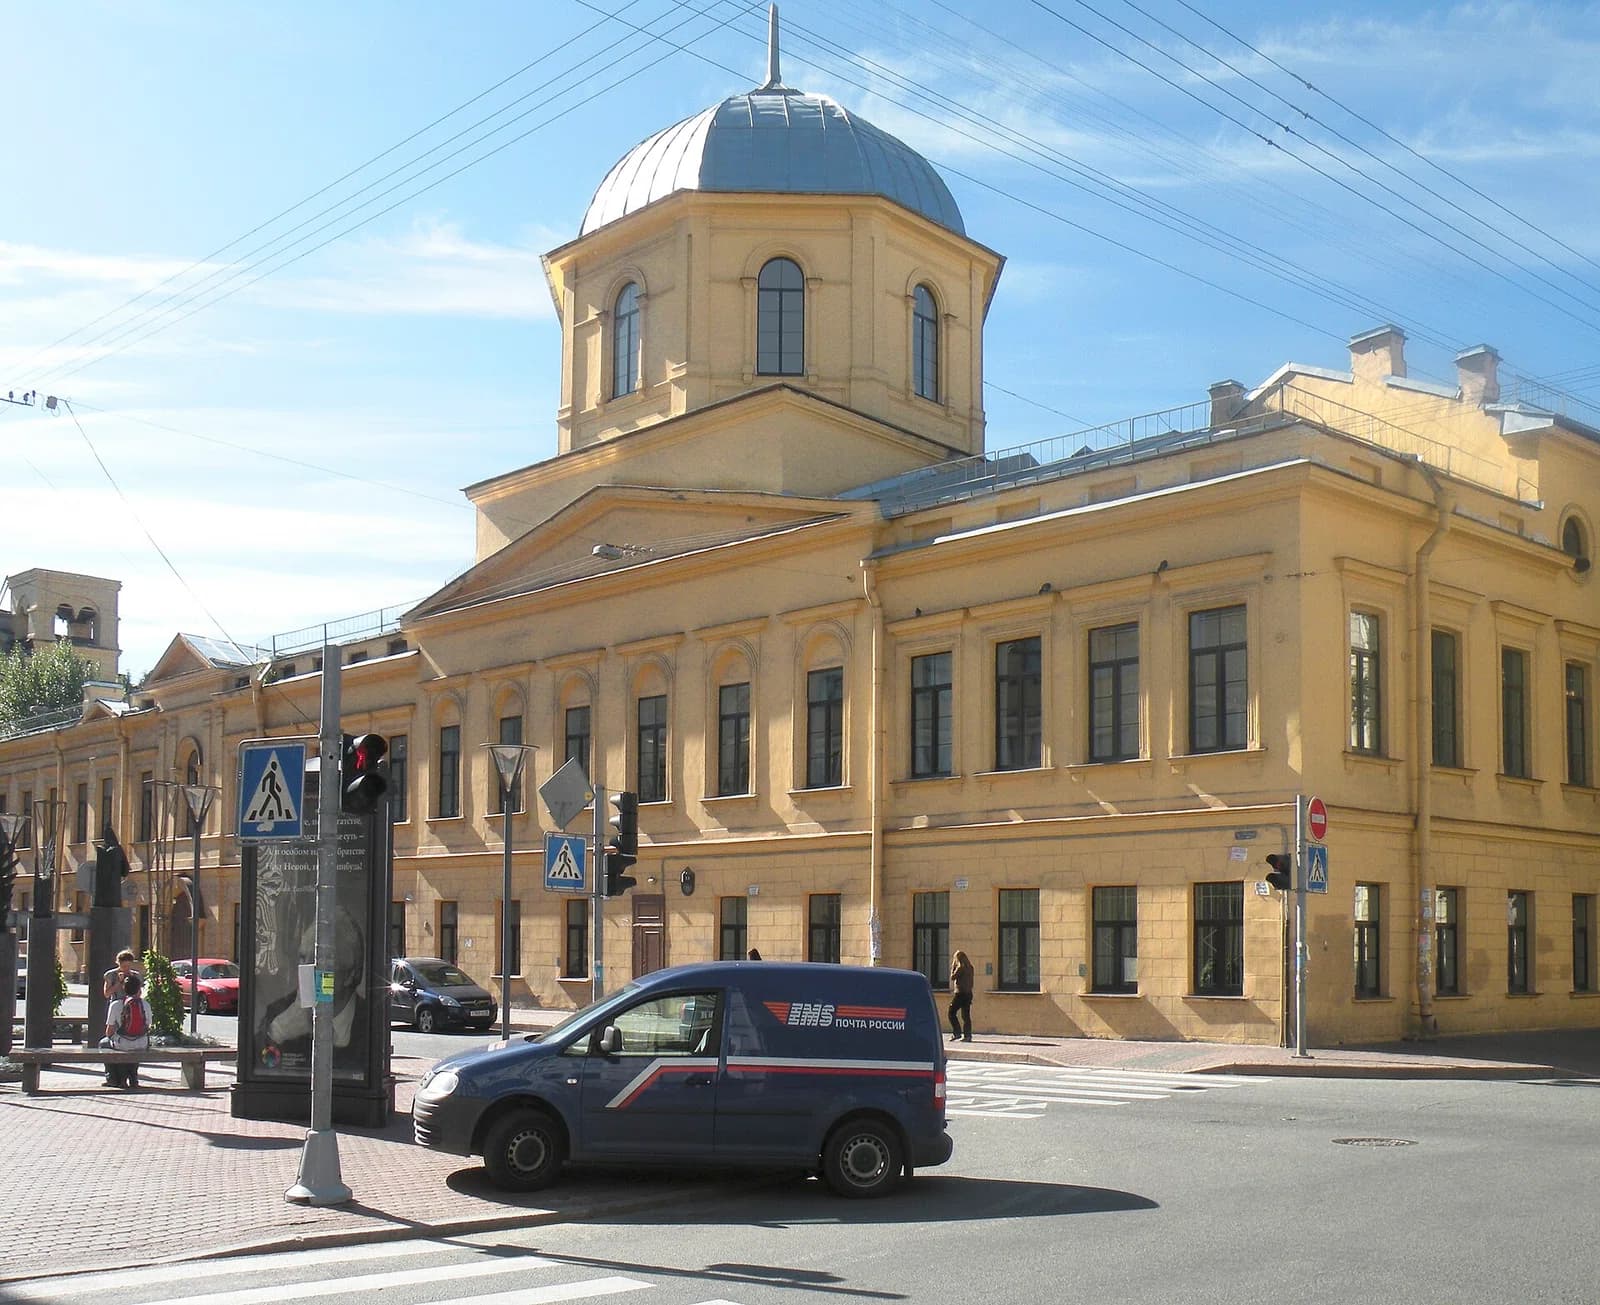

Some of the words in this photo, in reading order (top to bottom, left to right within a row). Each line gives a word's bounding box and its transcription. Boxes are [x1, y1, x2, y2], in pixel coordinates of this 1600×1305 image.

[281, 847, 309, 856] особом
[788, 1003, 835, 1027] EMS
[835, 1019, 867, 1029] ПОЧТА
[869, 1020, 905, 1031] РОССИИ
